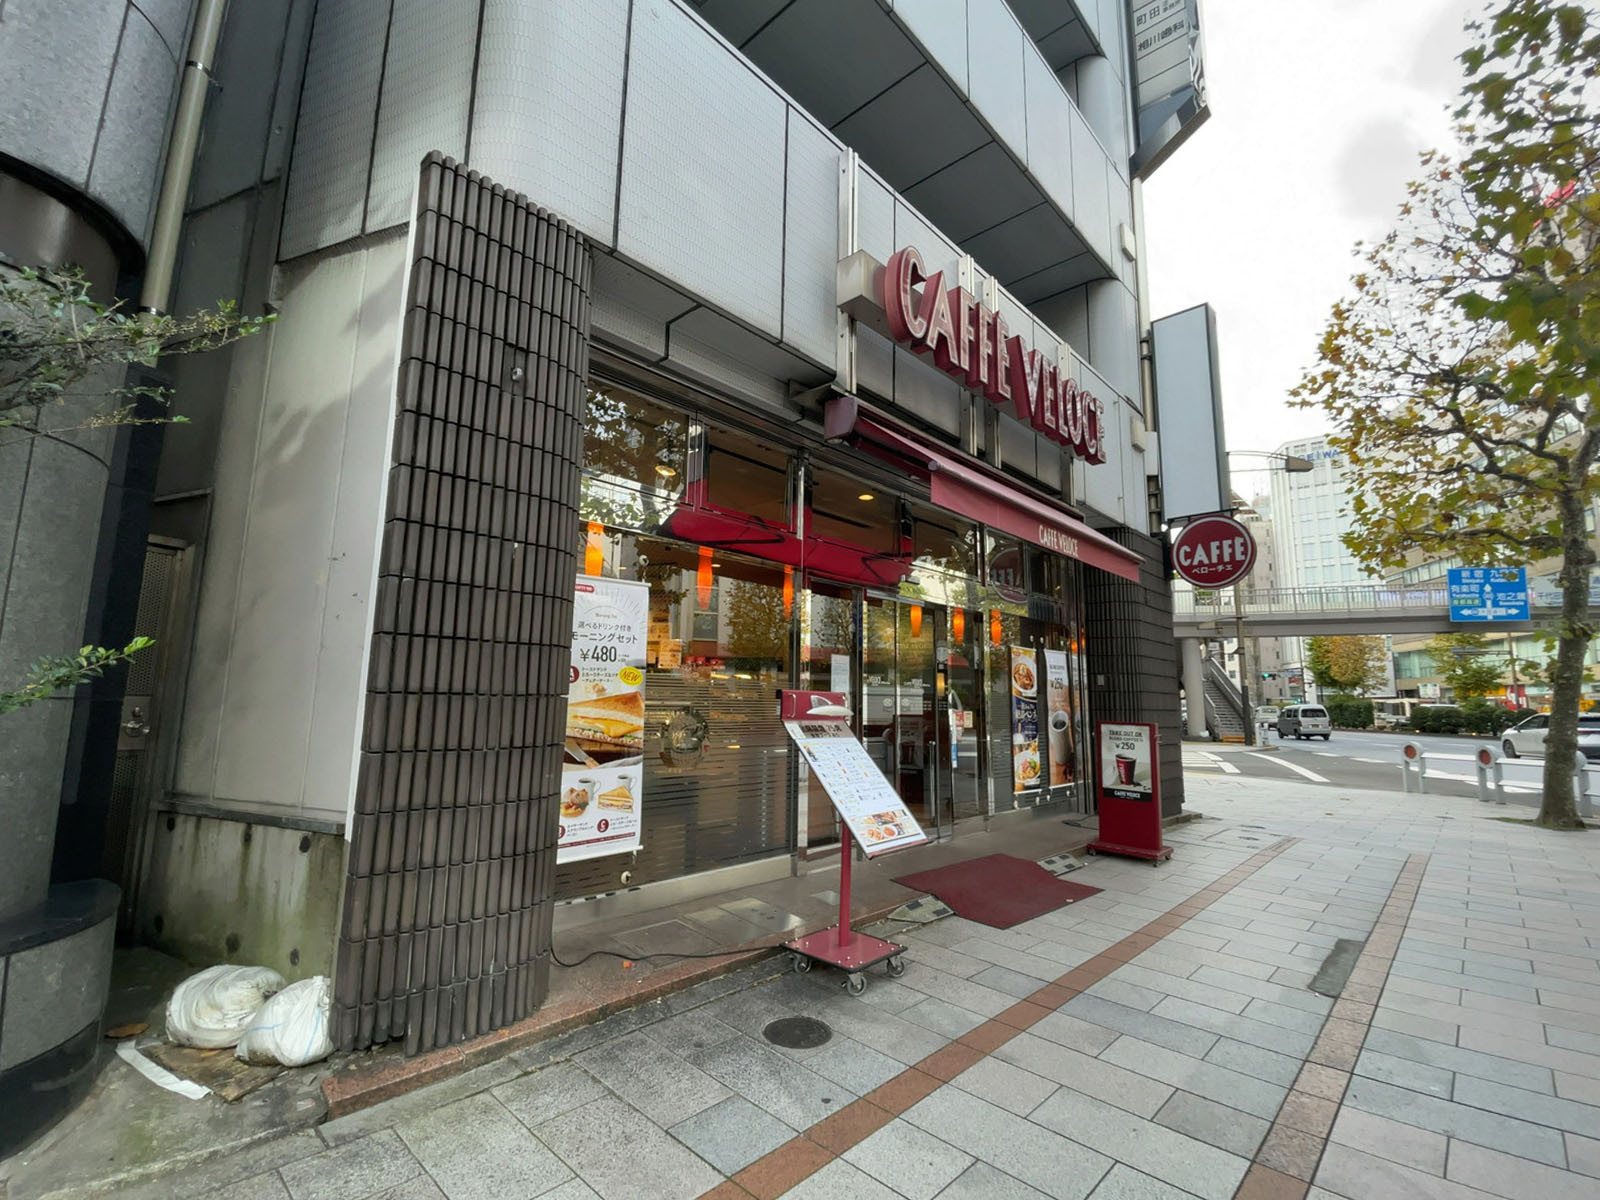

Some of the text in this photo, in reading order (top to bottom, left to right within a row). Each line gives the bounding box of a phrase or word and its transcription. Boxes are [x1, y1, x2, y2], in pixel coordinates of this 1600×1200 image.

[1136, 5, 1160, 26] 町田
[884, 245, 1107, 464] CAFFE VELOCE
[1179, 536, 1246, 567] CAFFE
[572, 631, 638, 644] モーニングセット
[580, 645, 617, 662] ¥480
[622, 671, 640, 682] NEW
